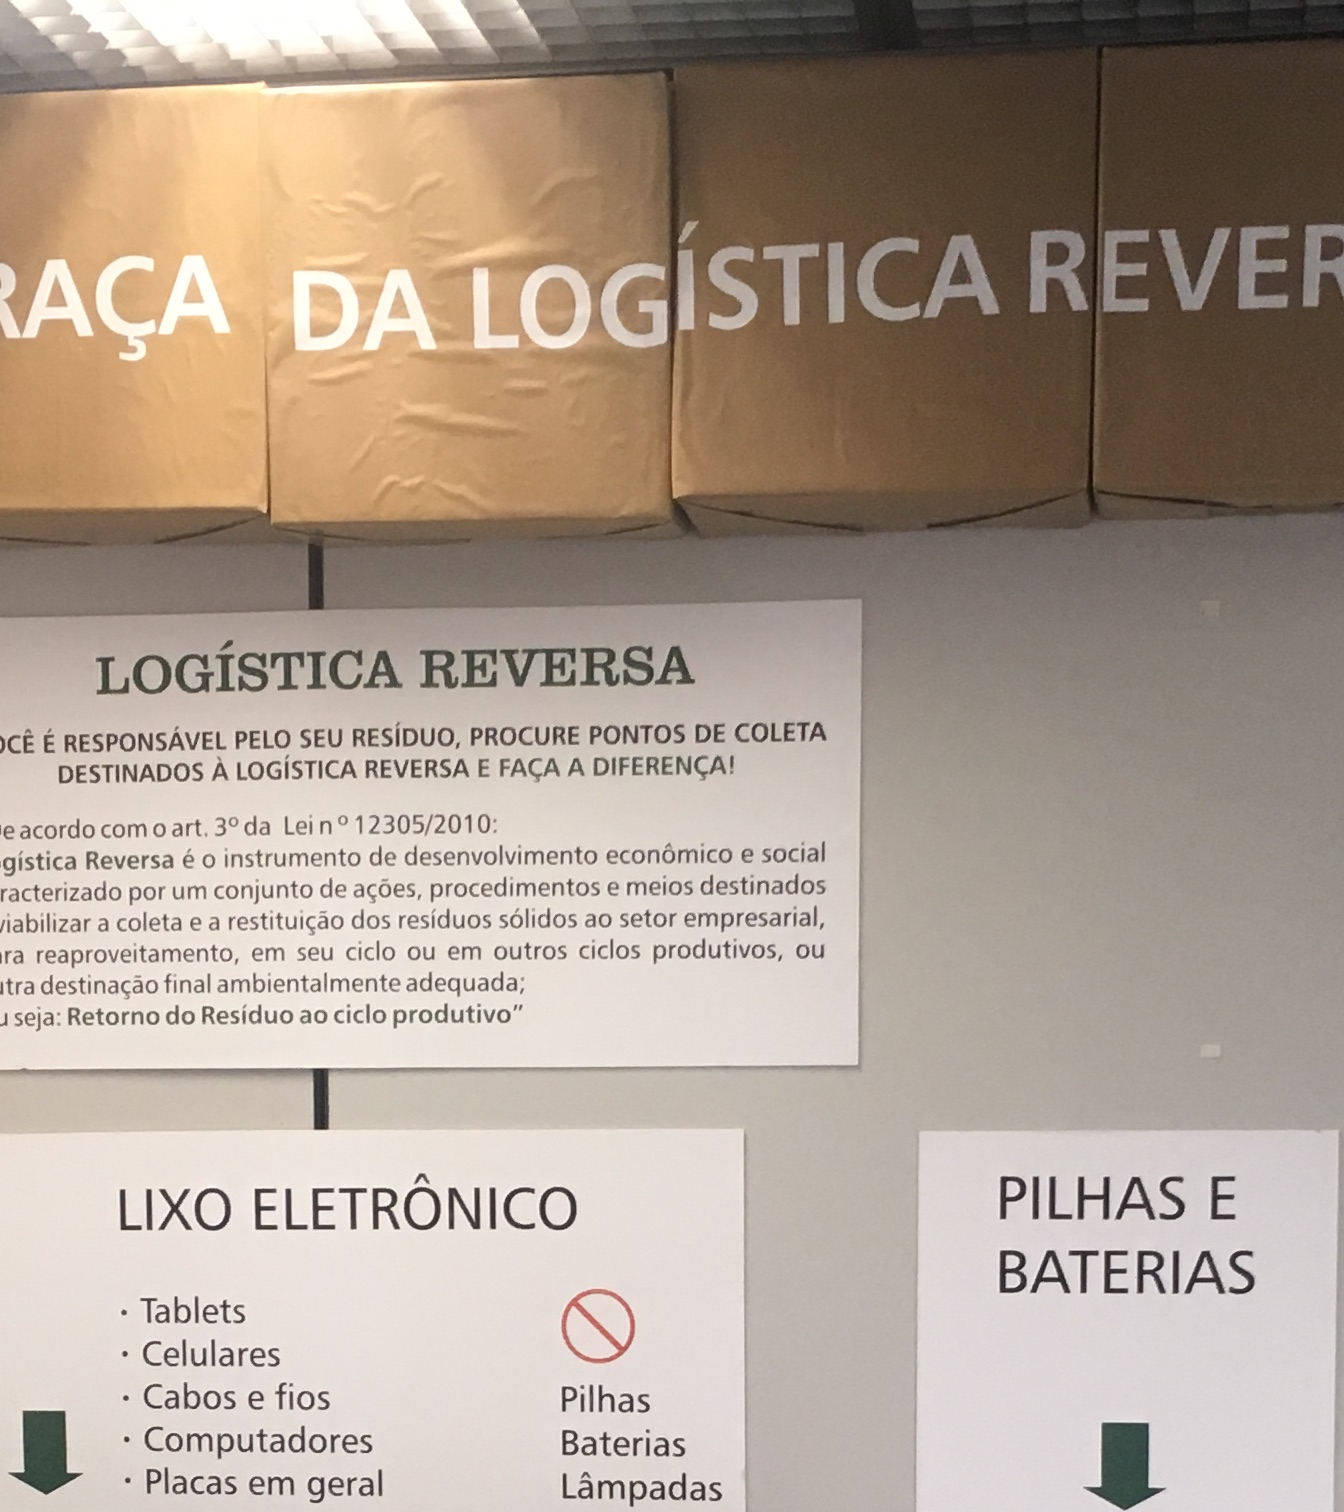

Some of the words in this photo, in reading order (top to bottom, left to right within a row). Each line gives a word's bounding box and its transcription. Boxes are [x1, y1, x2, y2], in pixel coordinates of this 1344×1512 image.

[293, 270, 436, 350] DA
[472, 220, 1000, 350] LOGÍSTICA
[96, 640, 402, 694] LOGÍSTICA
[420, 646, 695, 688] REVERSA
[44, 729, 55, 753] É
[65, 726, 226, 753] RESPONSÁVEL
[236, 730, 290, 749] PELO
[300, 729, 342, 748] SEU
[353, 722, 460, 749] RESÍDUO,
[471, 726, 579, 746] PROCURE
[590, 724, 685, 745] PONTOS
[695, 724, 725, 743] DE
[735, 722, 826, 742] COLETA
[59, 763, 203, 783] DESTINADOS
[212, 757, 228, 781] À
[237, 755, 357, 780] LOGÍSTICA
[366, 759, 469, 778] REVERSA
[478, 759, 489, 777] E
[500, 758, 560, 782] FAÇA
[568, 758, 584, 776] A
[594, 755, 734, 780] DIFERENÇA!
[20, 819, 95, 839] acordo
[101, 823, 147, 838] com
[153, 823, 166, 837] o
[172, 819, 207, 837] art.
[244, 816, 270, 836] da
[285, 816, 313, 835] Lei
[356, 814, 497, 836] 12305/2010:
[86, 851, 173, 870] Reversa
[183, 849, 194, 869] é
[202, 854, 215, 868] o
[225, 849, 361, 868] instrumento
[370, 846, 396, 866] de
[405, 845, 597, 866] desenvolvimento
[606, 843, 732, 864] econômico
[741, 848, 754, 863] e
[762, 841, 825, 863] social
[129, 886, 165, 905] por
[173, 886, 206, 900] um
[214, 879, 313, 904] conjunto
[320, 878, 346, 898] de
[354, 879, 421, 903] ações,
[431, 877, 600, 902] procedimentos
[607, 882, 619, 896] e
[627, 875, 693, 896] meios
[701, 873, 826, 895] destinados
[98, 918, 109, 932] a
[117, 912, 182, 932] coleta
[190, 917, 201, 931] e
[209, 917, 219, 931] a
[229, 911, 344, 935] restituição
[352, 909, 390, 929] dos
[399, 909, 491, 929] resíduos
[500, 908, 577, 929] sólidos
[585, 914, 612, 928] ao
[620, 910, 677, 927] setor
[684, 905, 824, 932] empresarial,
[37, 943, 238, 968] reaproveitamento,
[252, 947, 284, 962] em
[297, 947, 333, 961] seu
[346, 941, 395, 961] ciclo
[408, 946, 435, 960] ou
[448, 946, 481, 960] em
[494, 942, 567, 960] outros
[579, 939, 640, 959] ciclos
[654, 938, 782, 964] produtivos,
[796, 944, 824, 959] ou
[41, 975, 158, 999] destinação
[164, 973, 210, 993] final
[217, 972, 401, 993] ambientalmente
[406, 971, 524, 997] adequada;
[15, 1012, 60, 1032] seja:
[68, 1008, 159, 1025] Retorno
[166, 1005, 195, 1025] do
[202, 1004, 293, 1024] Resíduo
[300, 1010, 327, 1024] ao
[334, 1004, 386, 1024] ciclo
[120, 1188, 231, 1231] LIXO
[255, 1173, 577, 1230] ELETRÔNICO
[1000, 1176, 1185, 1220] PILHAS
[1211, 1176, 1235, 1219] E
[1000, 1250, 1255, 1294] BATERIAS
[140, 1296, 245, 1323] Tablets
[143, 1339, 280, 1367] Celulares
[144, 1382, 236, 1409] Cabos
[248, 1391, 264, 1410] e
[275, 1382, 330, 1410] fios
[562, 1385, 650, 1413] Pilhas
[145, 1426, 372, 1459] Computadores
[562, 1429, 685, 1457] Baterias
[147, 1467, 237, 1495] Placas
[249, 1476, 294, 1495] em
[308, 1469, 382, 1503] geral
[563, 1472, 722, 1507] Lâmpadas
